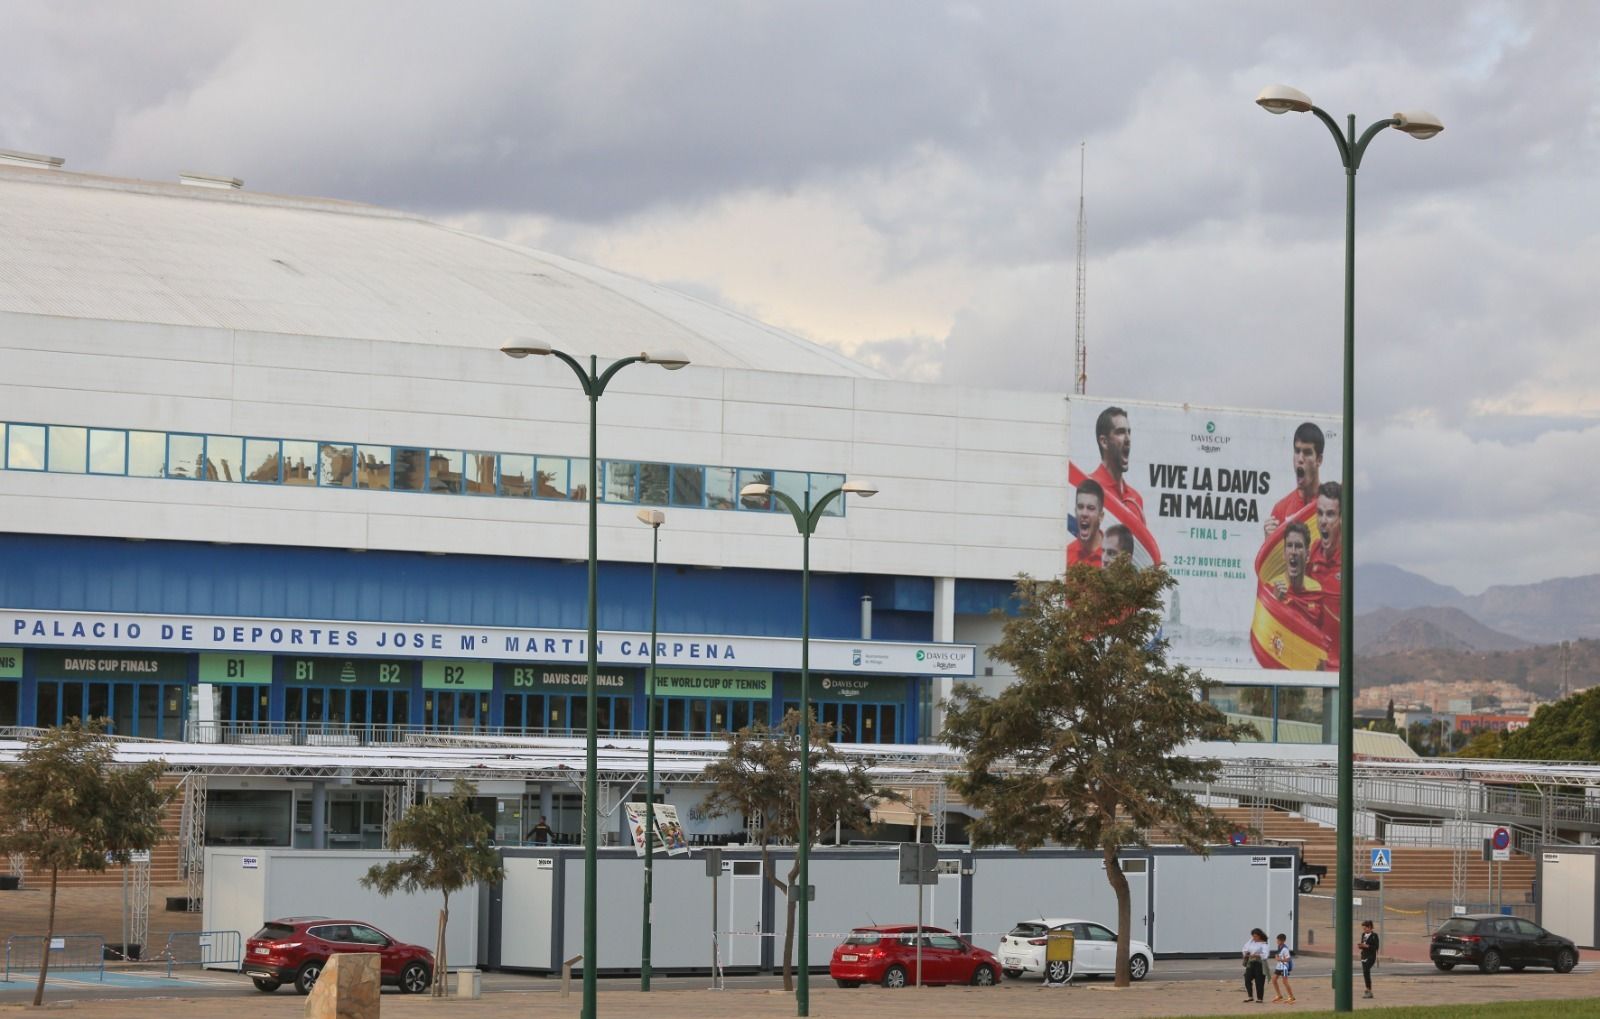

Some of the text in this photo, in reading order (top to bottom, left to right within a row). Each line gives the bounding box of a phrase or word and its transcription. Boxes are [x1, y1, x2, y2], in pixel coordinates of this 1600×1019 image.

[1191, 434, 1231, 445] DAVIS CUP
[1149, 464, 1271, 495] VIVE LA DAVIS
[1159, 492, 1259, 522] EN MÁLAGA
[1190, 528, 1228, 540] FINAL 8
[1174, 555, 1241, 568] 22-27 NOVIEMBRE
[1192, 570, 1218, 578] CARPENA
[14, 620, 141, 638] PALACIO
[162, 624, 193, 640] DE
[214, 626, 358, 646] DEPORTES
[376, 632, 442, 649] JOSE
[620, 641, 736, 659] CARPENA
[926, 651, 966, 662] DAVIS CUP
[64, 658, 158, 672] DAVIS CUP FINALS
[227, 659, 244, 678] B1
[296, 661, 314, 680] B1
[380, 664, 400, 683] B2
[444, 666, 464, 684] B2
[514, 668, 534, 687] B3
[543, 672, 624, 686] DAVIS CUP INALS
[671, 678, 702, 688] WORLD
[704, 678, 720, 689] CUP
[722, 679, 733, 689] OF
[736, 679, 766, 690] TENNIS
[832, 680, 869, 689] DAVIS CUP
